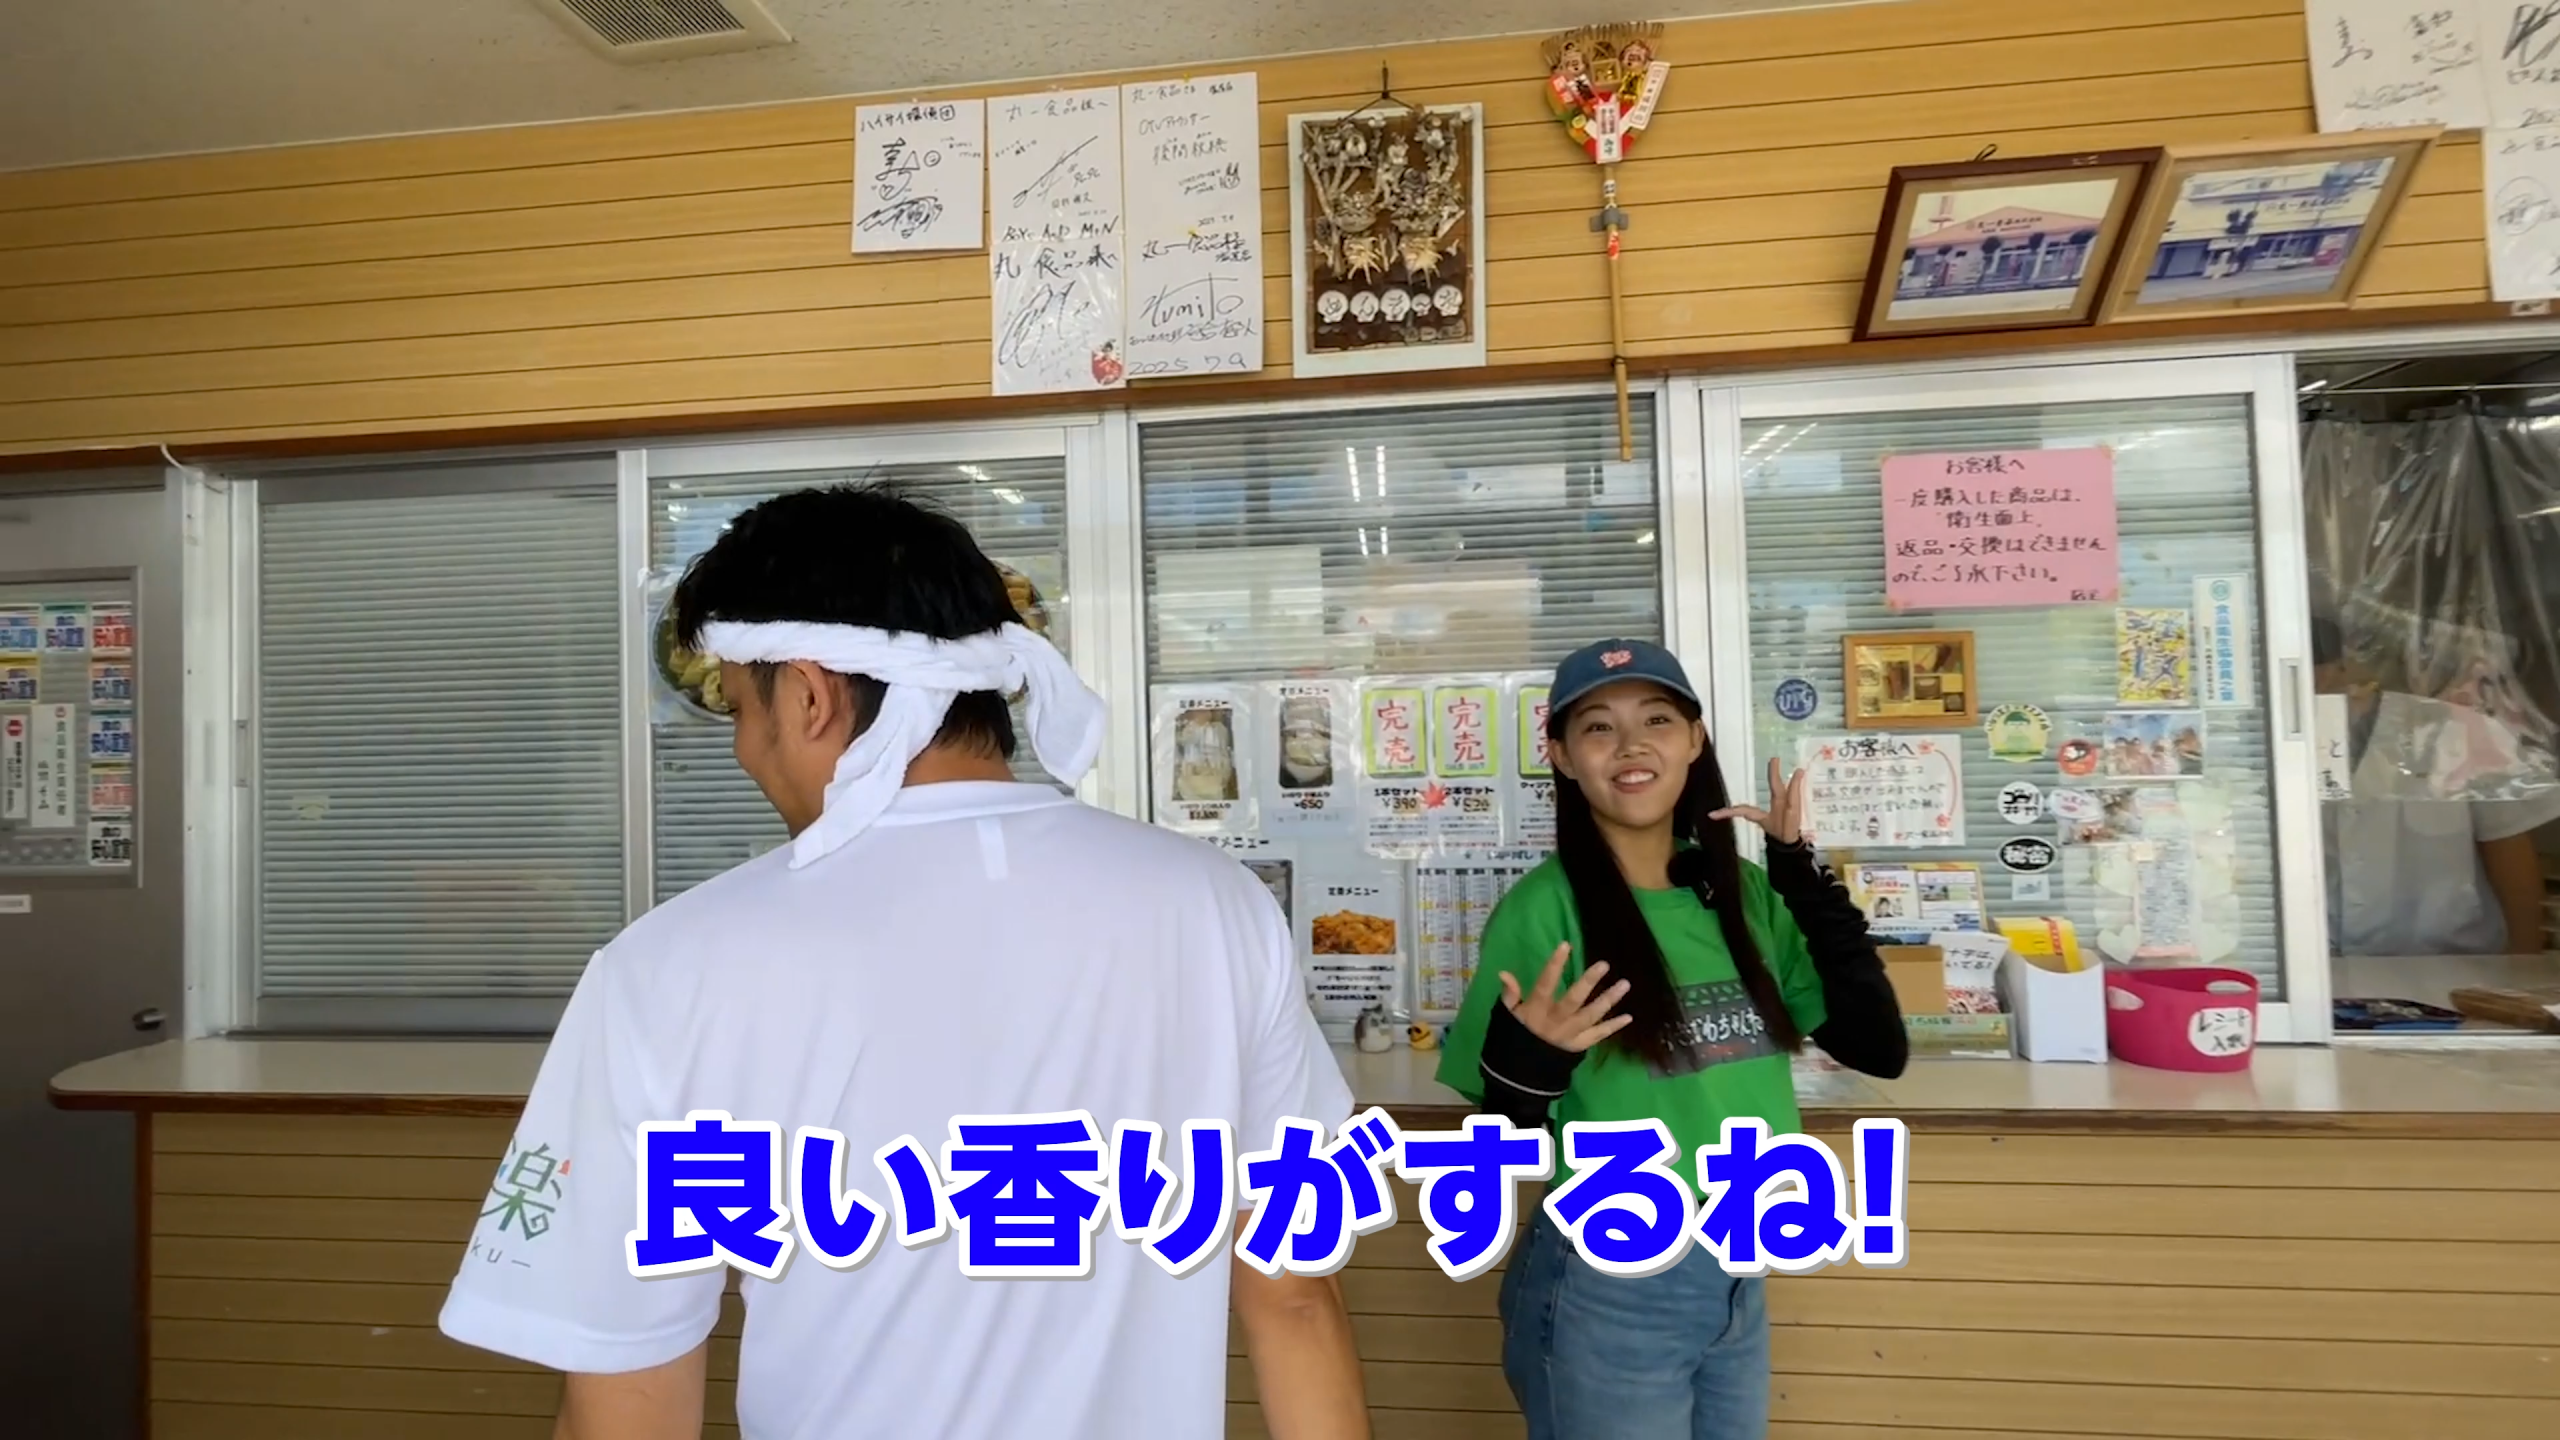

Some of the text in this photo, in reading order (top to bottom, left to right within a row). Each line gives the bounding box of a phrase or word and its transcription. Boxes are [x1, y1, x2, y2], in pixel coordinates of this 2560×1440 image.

[1128, 357, 1189, 376] 2025
[1945, 455, 2026, 475] お客様へ
[1896, 534, 2108, 557] 返品・交換はできません
[1377, 698, 1416, 764] 完売
[1447, 695, 1485, 764] 完売
[1838, 738, 1916, 758] お客様へ
[1328, 887, 1379, 896] 定番メニュー
